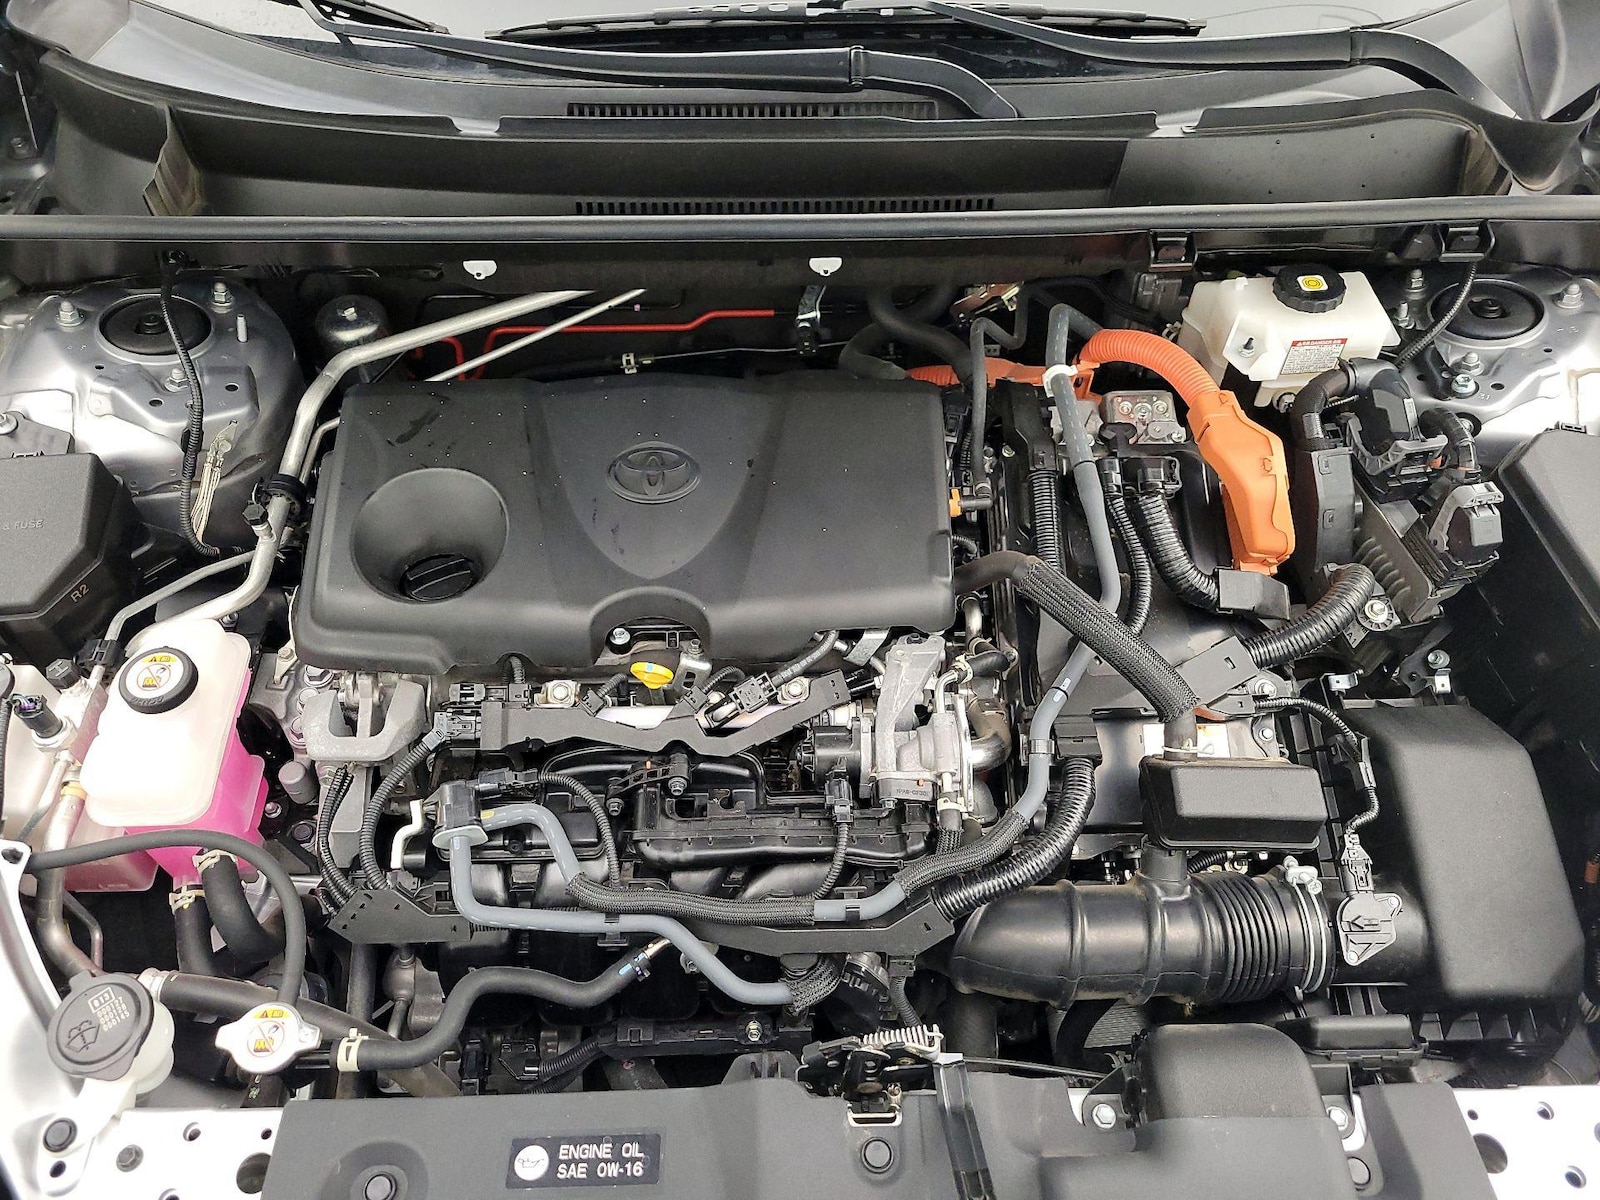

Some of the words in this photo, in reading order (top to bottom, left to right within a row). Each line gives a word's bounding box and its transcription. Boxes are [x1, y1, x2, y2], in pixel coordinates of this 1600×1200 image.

[14, 519, 45, 530] FUSE
[70, 584, 90, 602] R2
[558, 1143, 613, 1160] ENGINE
[621, 1142, 645, 1158] OIL
[556, 1163, 588, 1179] SAE
[597, 1161, 644, 1178] 0W-16
